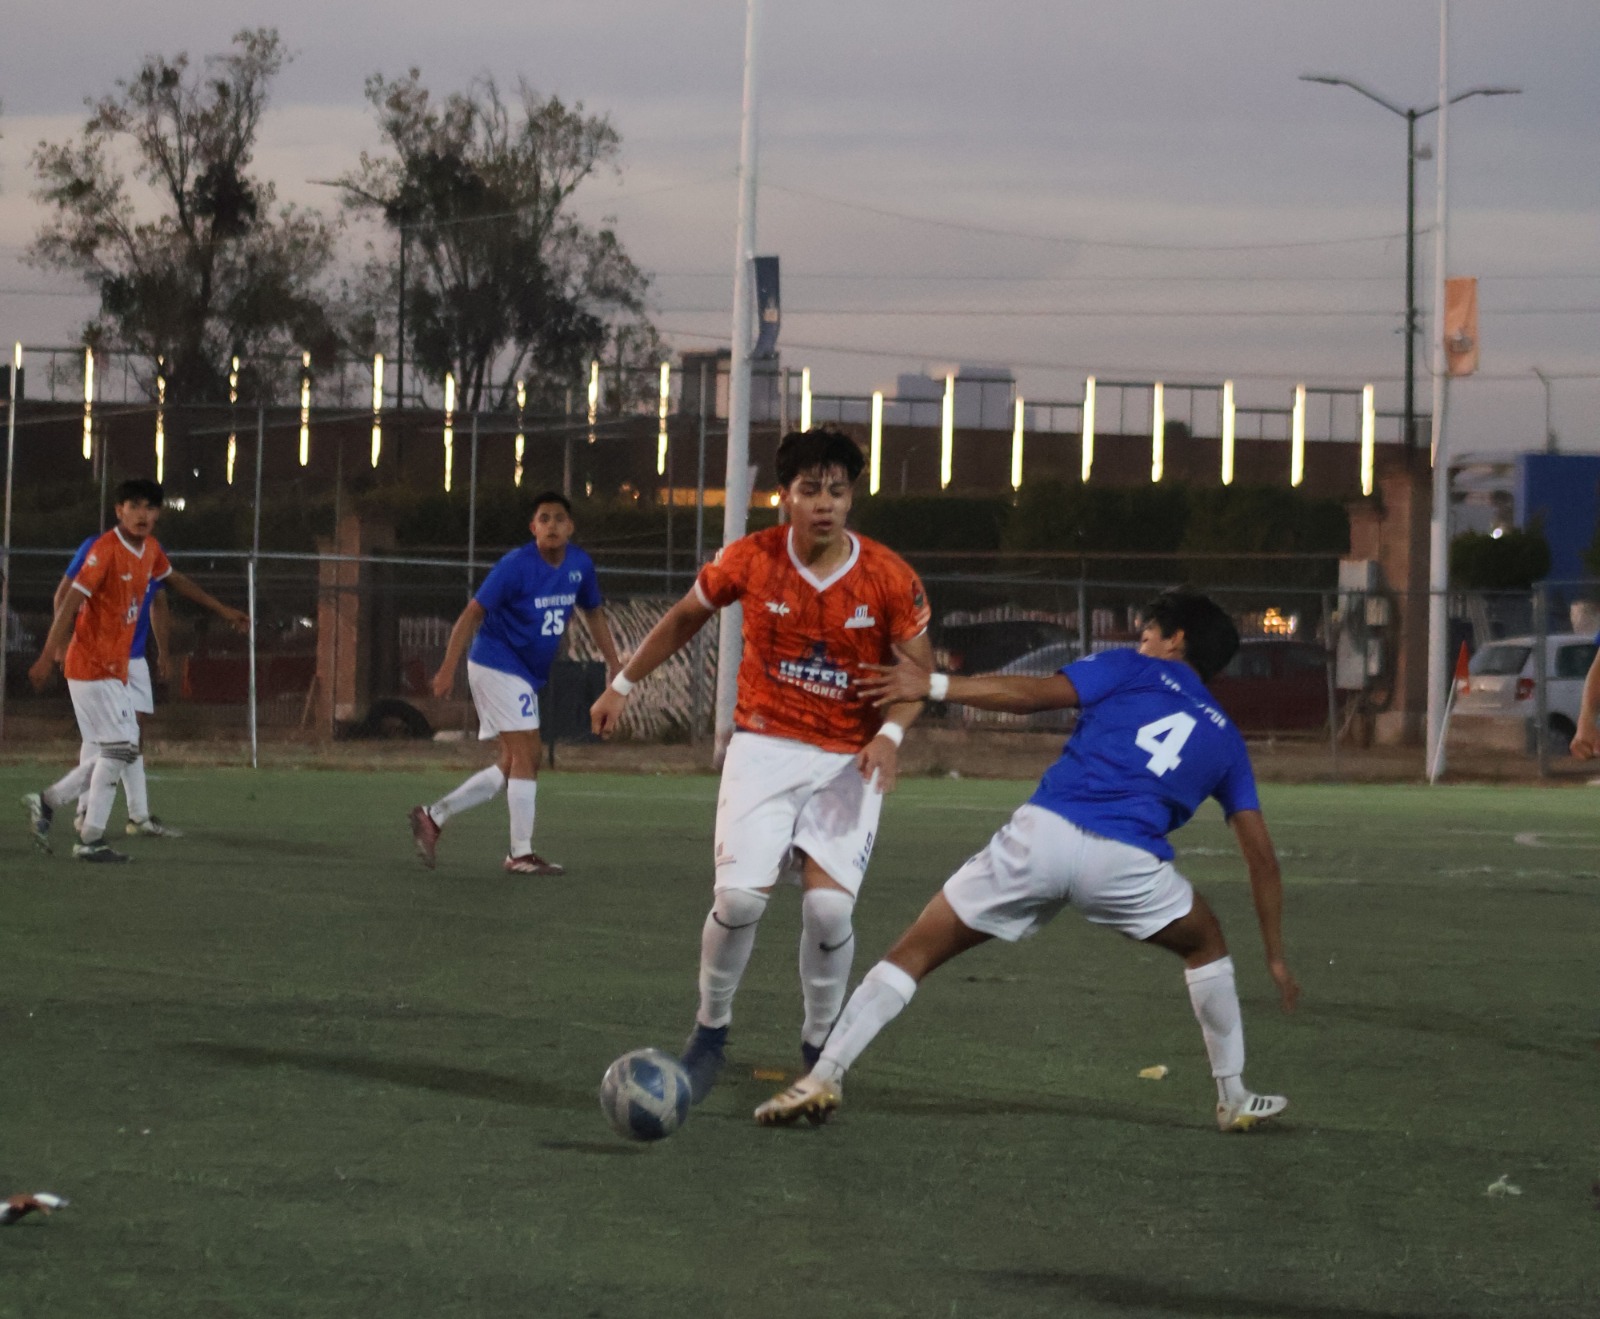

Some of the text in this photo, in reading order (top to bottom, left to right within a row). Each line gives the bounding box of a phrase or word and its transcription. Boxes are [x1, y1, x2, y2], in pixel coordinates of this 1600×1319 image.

[541, 609, 564, 635] 25
[518, 693, 538, 717] 2
[1135, 711, 1198, 777] 4
